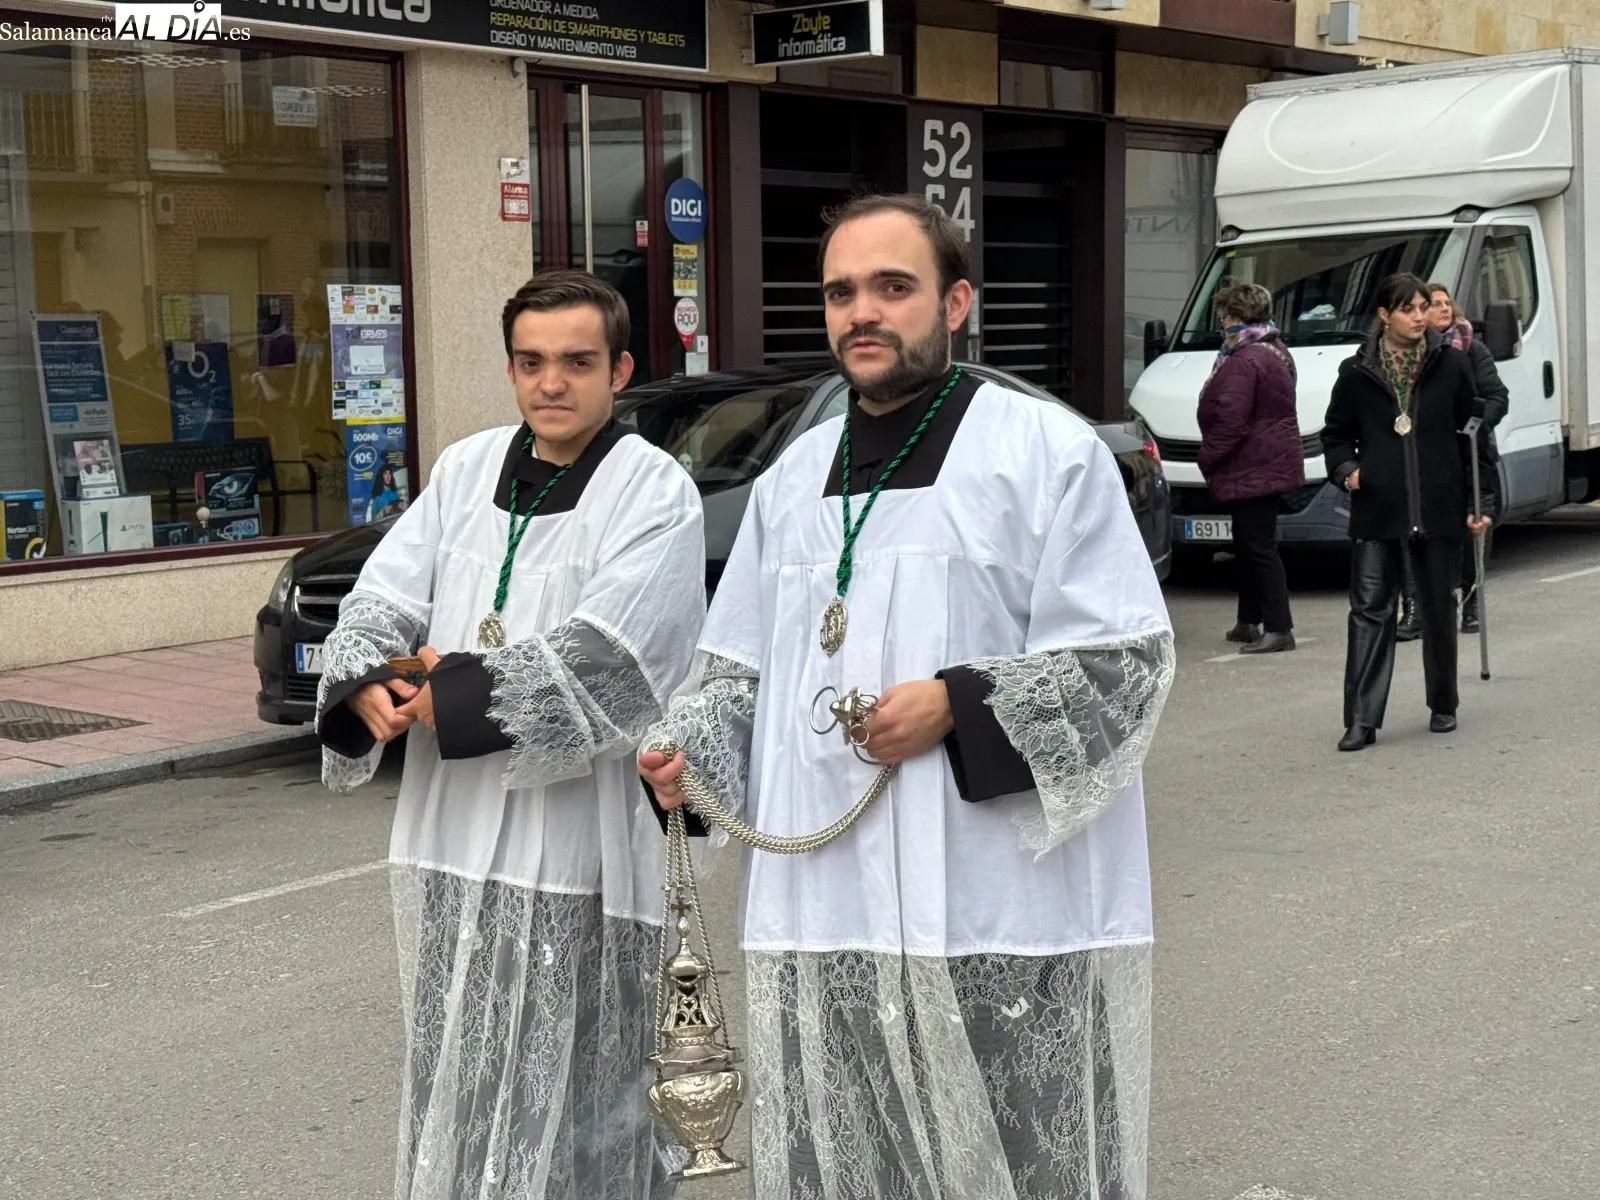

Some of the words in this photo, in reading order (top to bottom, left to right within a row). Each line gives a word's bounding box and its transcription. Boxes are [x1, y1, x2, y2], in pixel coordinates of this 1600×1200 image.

[552, 3, 561, 15] A
[563, 4, 599, 20] MEDIDA
[490, 12, 550, 32] REPARACIÓN
[552, 20, 567, 34] DE
[568, 21, 637, 42] SMARTPHONES
[638, 30, 645, 42] Y
[646, 31, 685, 47] TABLETS
[792, 11, 831, 36] Zbyte
[490, 30, 527, 47] DISEÑO
[528, 35, 536, 48] Y
[537, 36, 614, 57] MANTENIMIENTO
[615, 44, 636, 59] WEB
[778, 33, 846, 58] informática
[922, 119, 973, 179] 52
[670, 198, 702, 217] DIGI
[353, 432, 379, 442] 500Mb
[387, 427, 403, 436] DIGI
[354, 451, 373, 465] 10€
